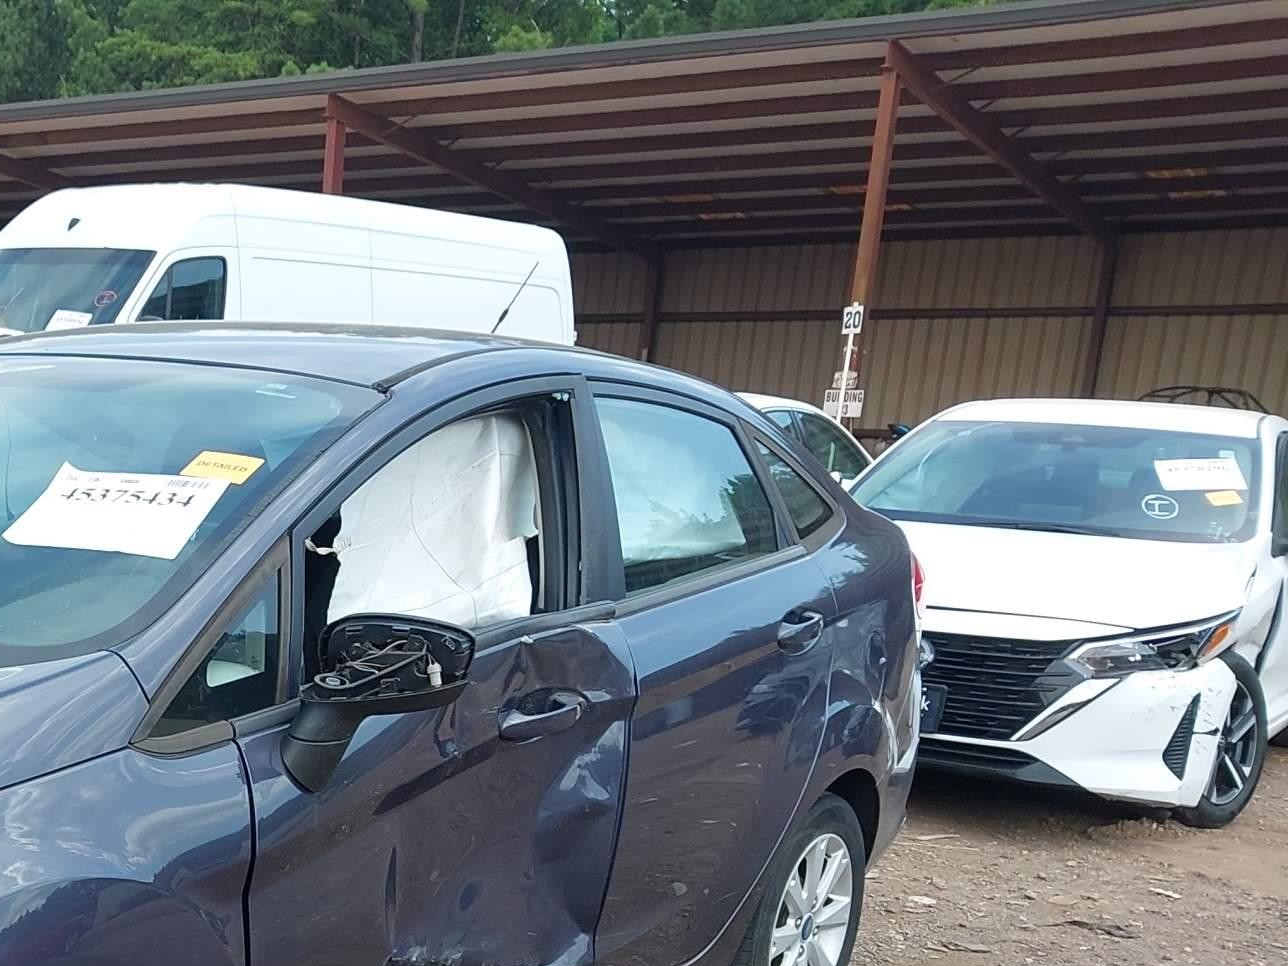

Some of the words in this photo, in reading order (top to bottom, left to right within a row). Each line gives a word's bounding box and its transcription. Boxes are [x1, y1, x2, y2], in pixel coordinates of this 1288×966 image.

[844, 310, 862, 330] 20
[826, 391, 863, 403] BUIDING
[196, 459, 249, 473] DETAILED
[60, 487, 196, 508] 45375434
